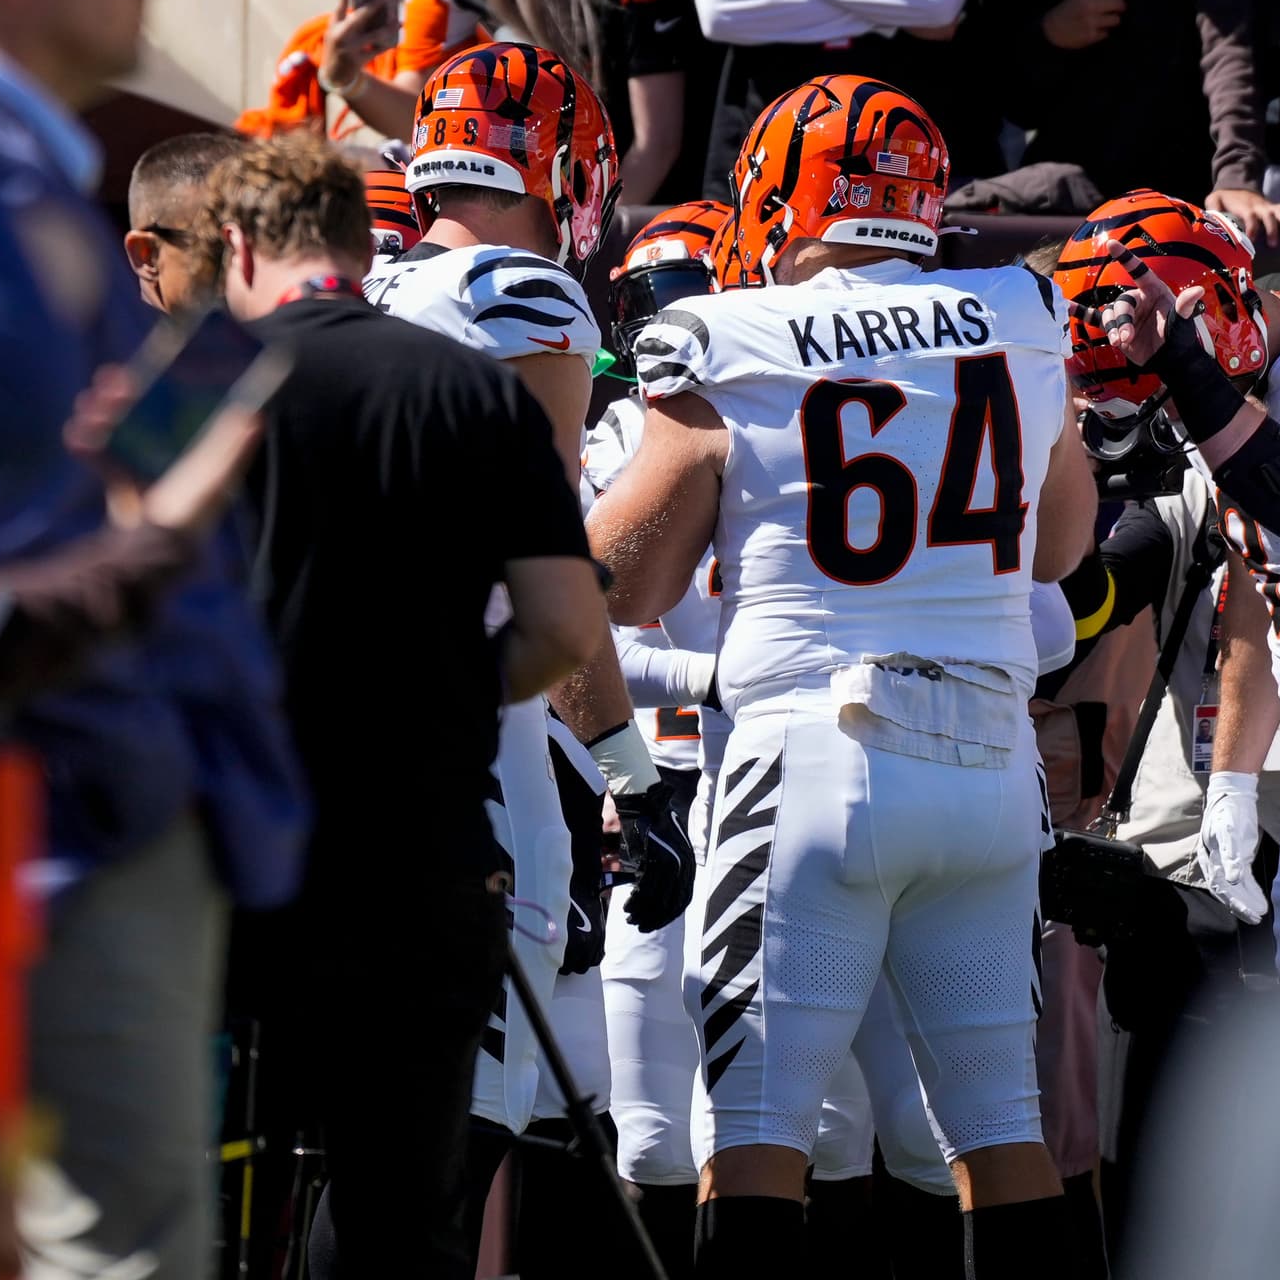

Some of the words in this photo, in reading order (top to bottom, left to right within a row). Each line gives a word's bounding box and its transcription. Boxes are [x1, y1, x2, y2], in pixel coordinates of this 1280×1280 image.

[413, 160, 495, 177] BENGALS
[855, 227, 935, 248] BENGALS
[787, 297, 990, 367] KARRAS
[800, 350, 1030, 587] 64
